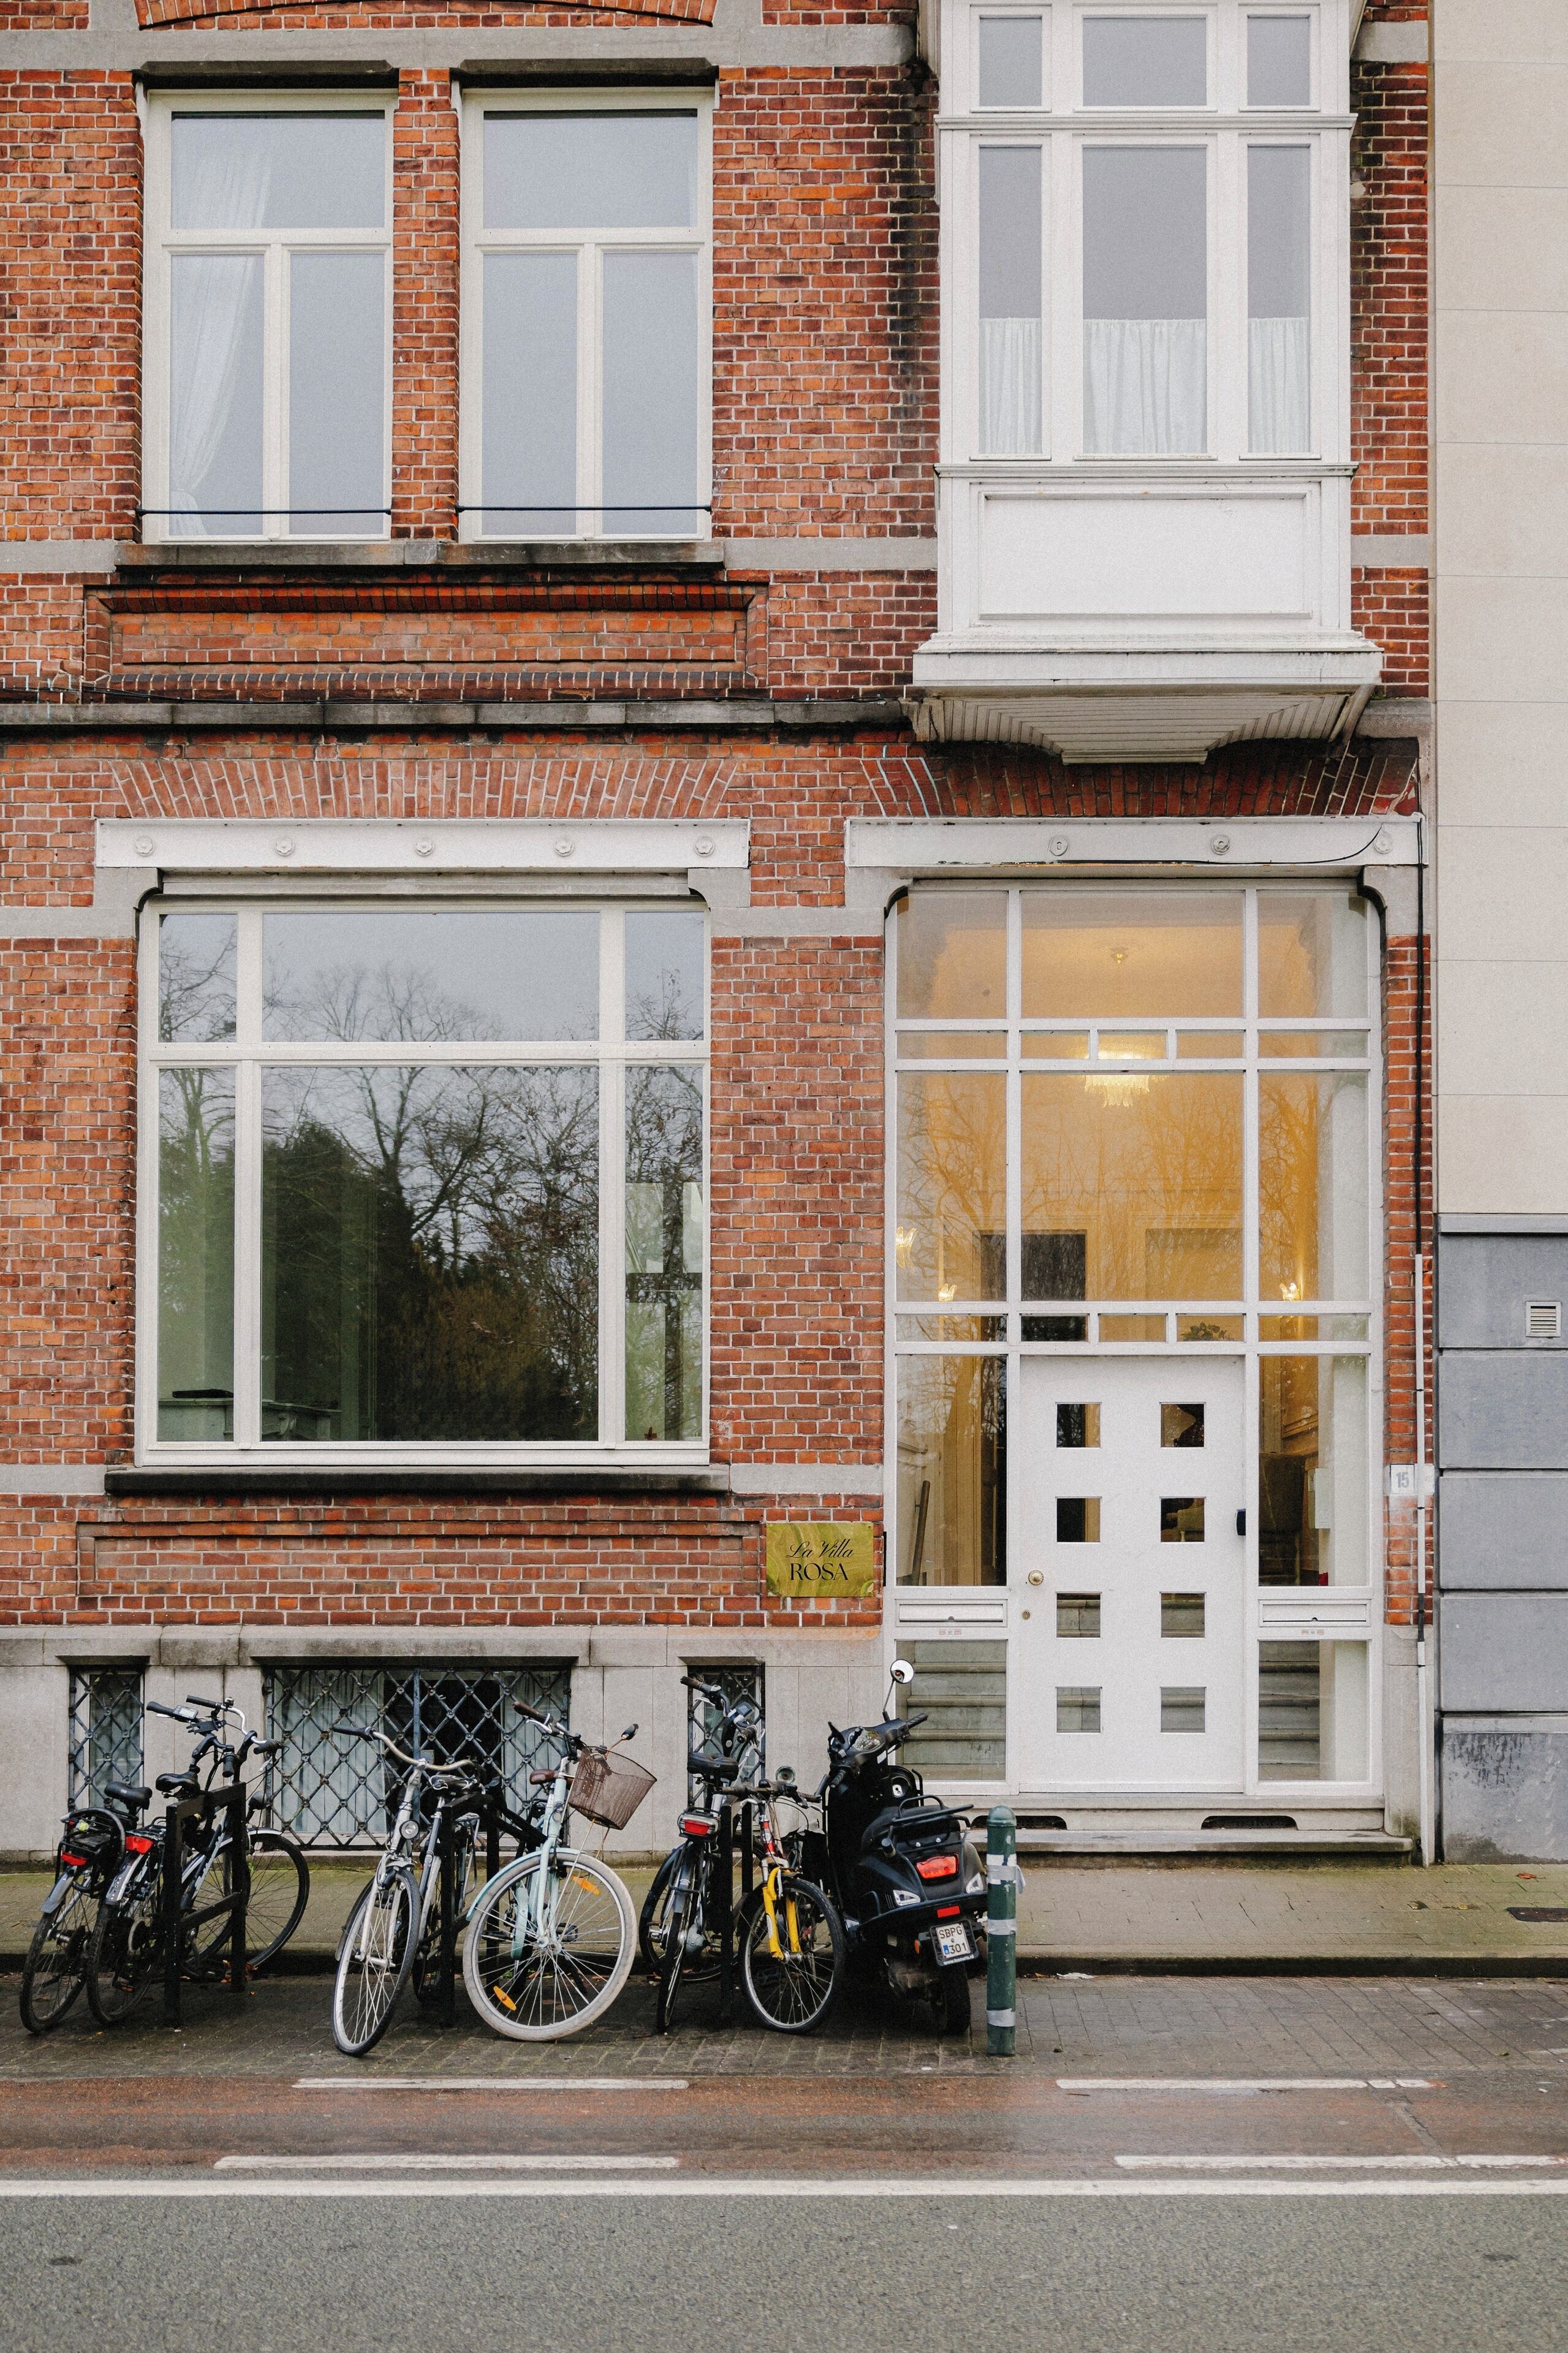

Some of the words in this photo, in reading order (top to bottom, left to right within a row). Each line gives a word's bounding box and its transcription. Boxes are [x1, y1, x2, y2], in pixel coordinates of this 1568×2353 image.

[1396, 1472, 1409, 1488] 15
[786, 1540, 814, 1558] La
[817, 1539, 855, 1558] Villa
[790, 1563, 849, 1581] ROSA
[939, 1926, 963, 1939] SBPG
[949, 1942, 967, 1954] 301
